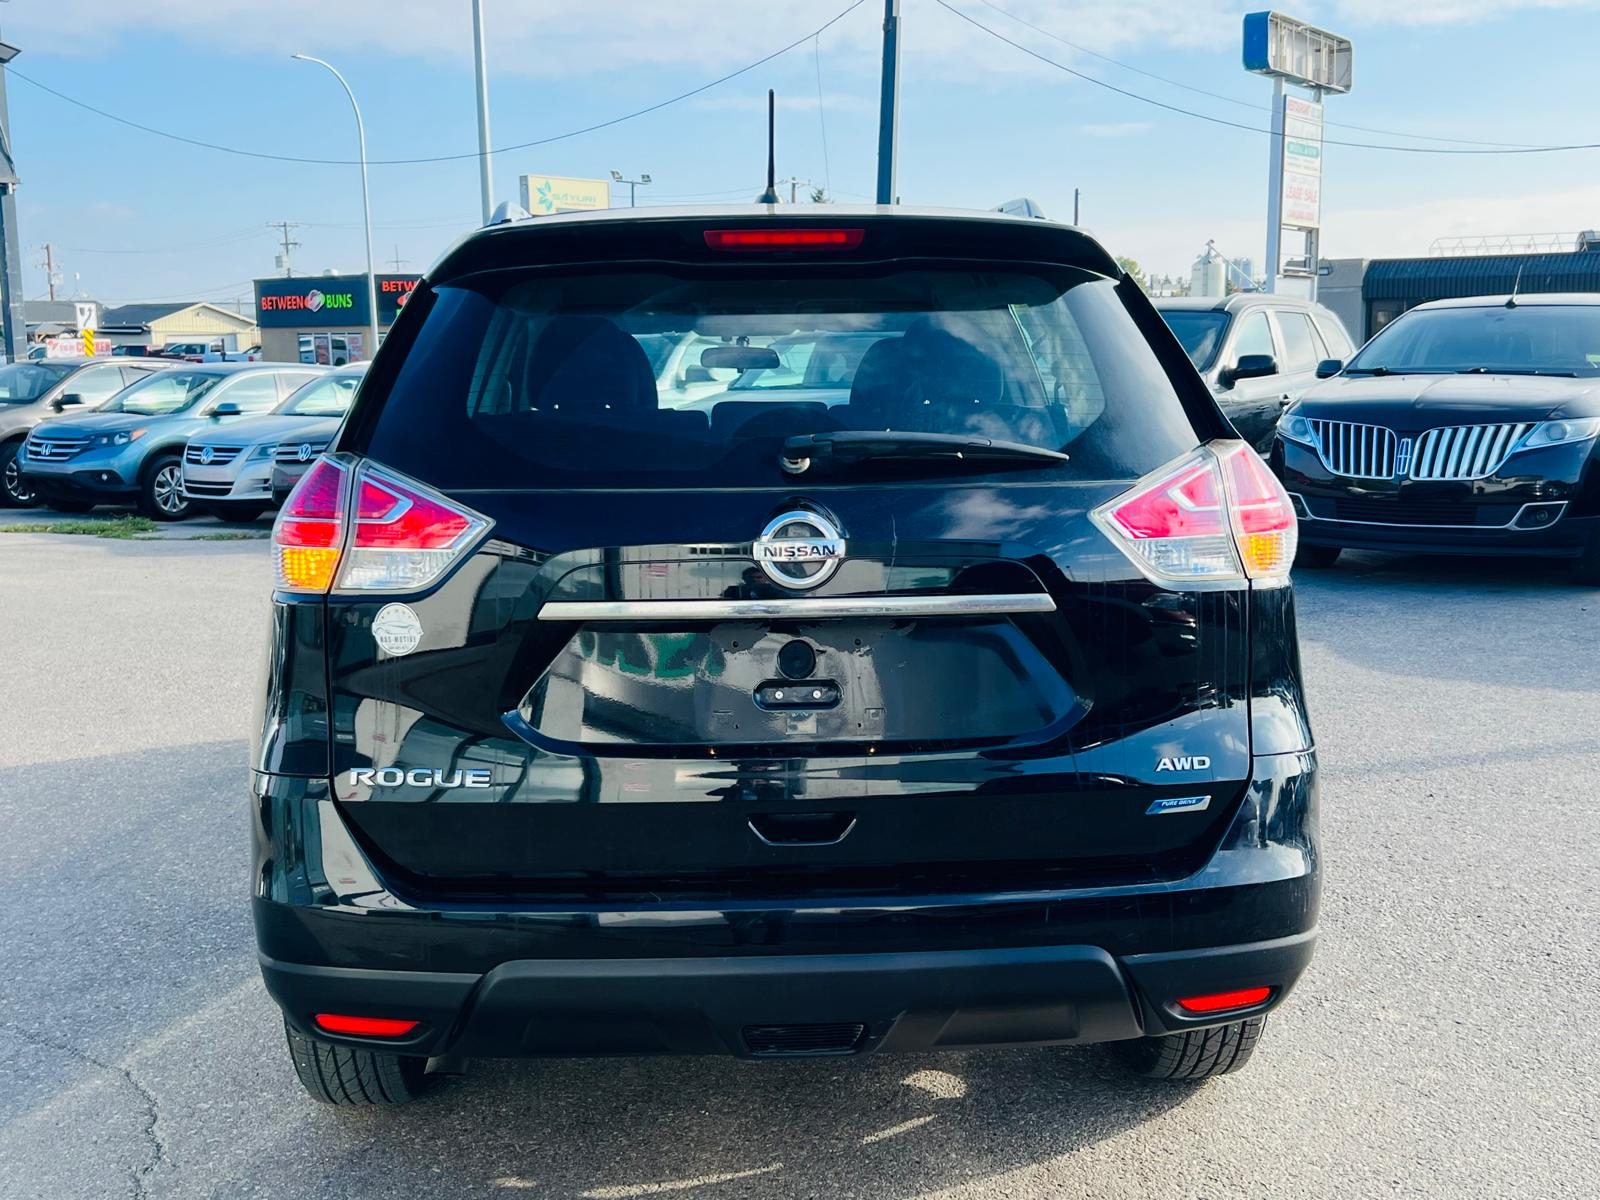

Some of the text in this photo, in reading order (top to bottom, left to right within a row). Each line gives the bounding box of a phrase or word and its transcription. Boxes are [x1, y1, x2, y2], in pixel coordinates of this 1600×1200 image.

[261, 294, 352, 310] BETWEEN BUNS
[764, 545, 835, 557] NISSAN
[1155, 756, 1211, 772] AWD
[350, 767, 491, 788] ROGUE
